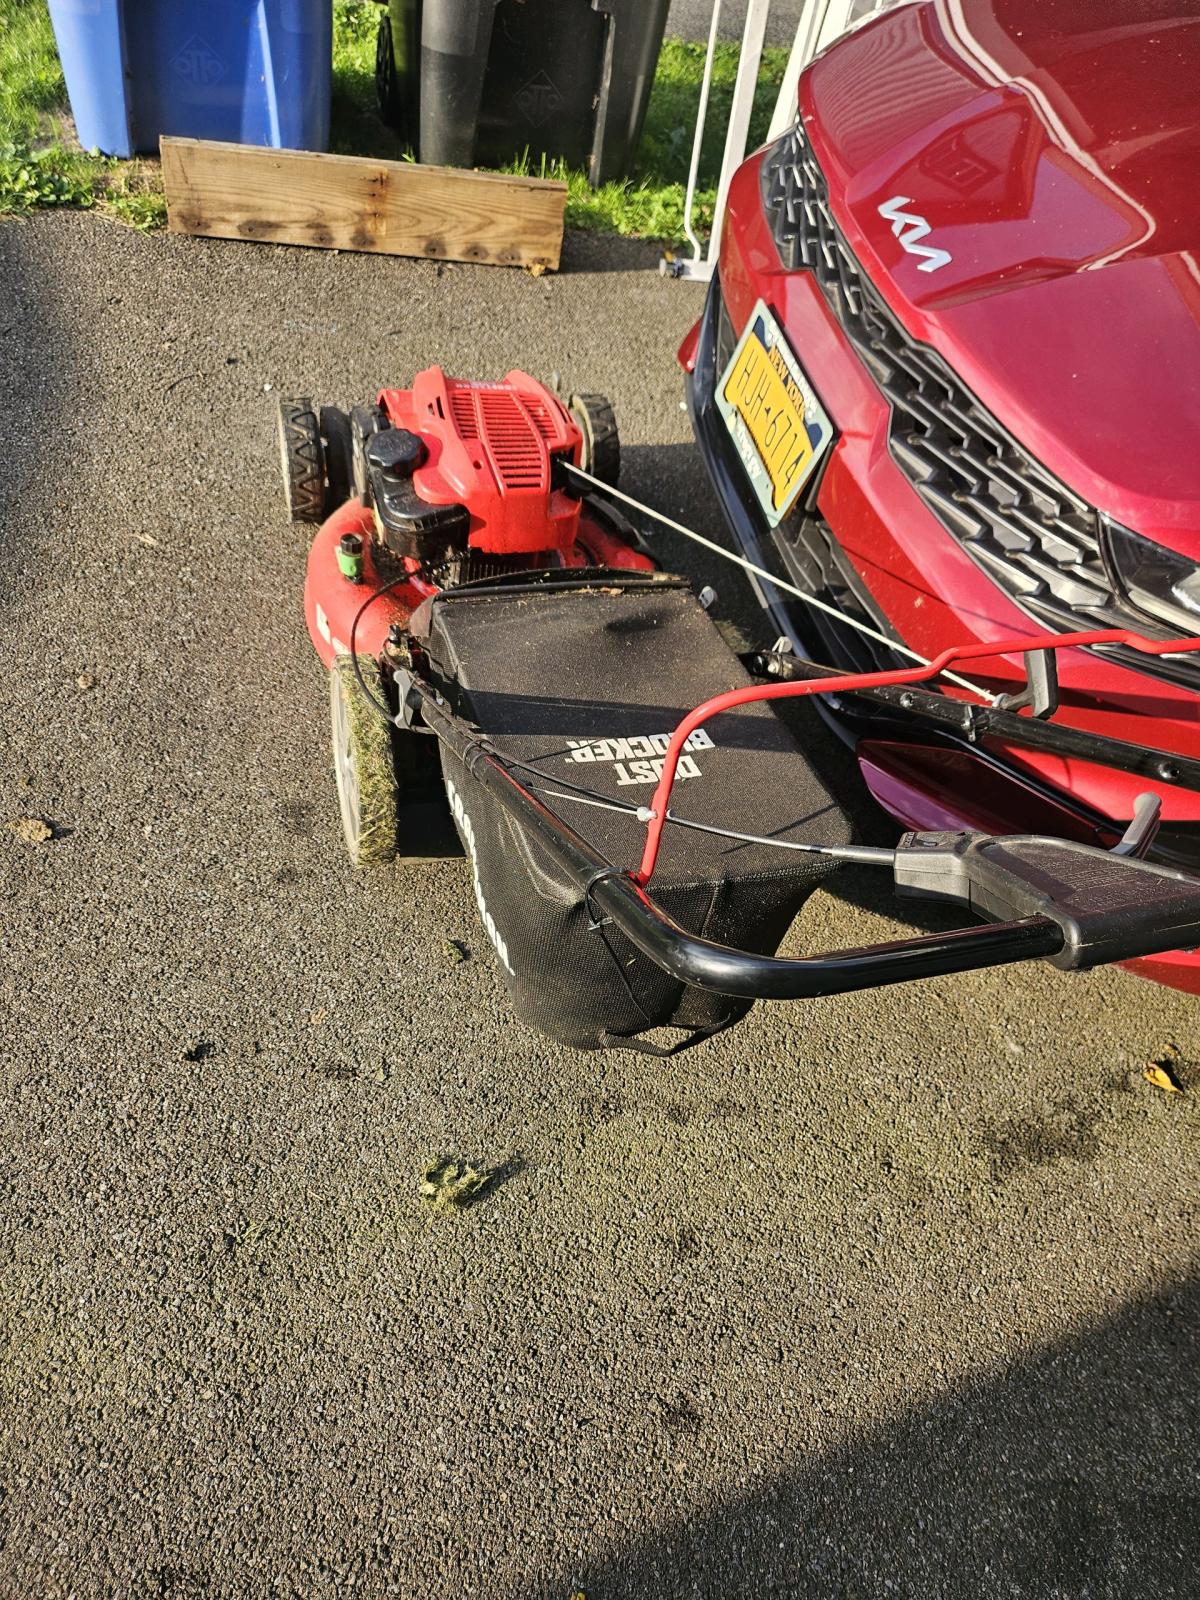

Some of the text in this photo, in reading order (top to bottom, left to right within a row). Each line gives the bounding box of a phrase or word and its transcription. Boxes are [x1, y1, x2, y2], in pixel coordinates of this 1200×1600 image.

[878, 196, 952, 273] KIA
[766, 343, 789, 383] NEW
[783, 373, 809, 422] YORK
[614, 755, 703, 786] DUST
